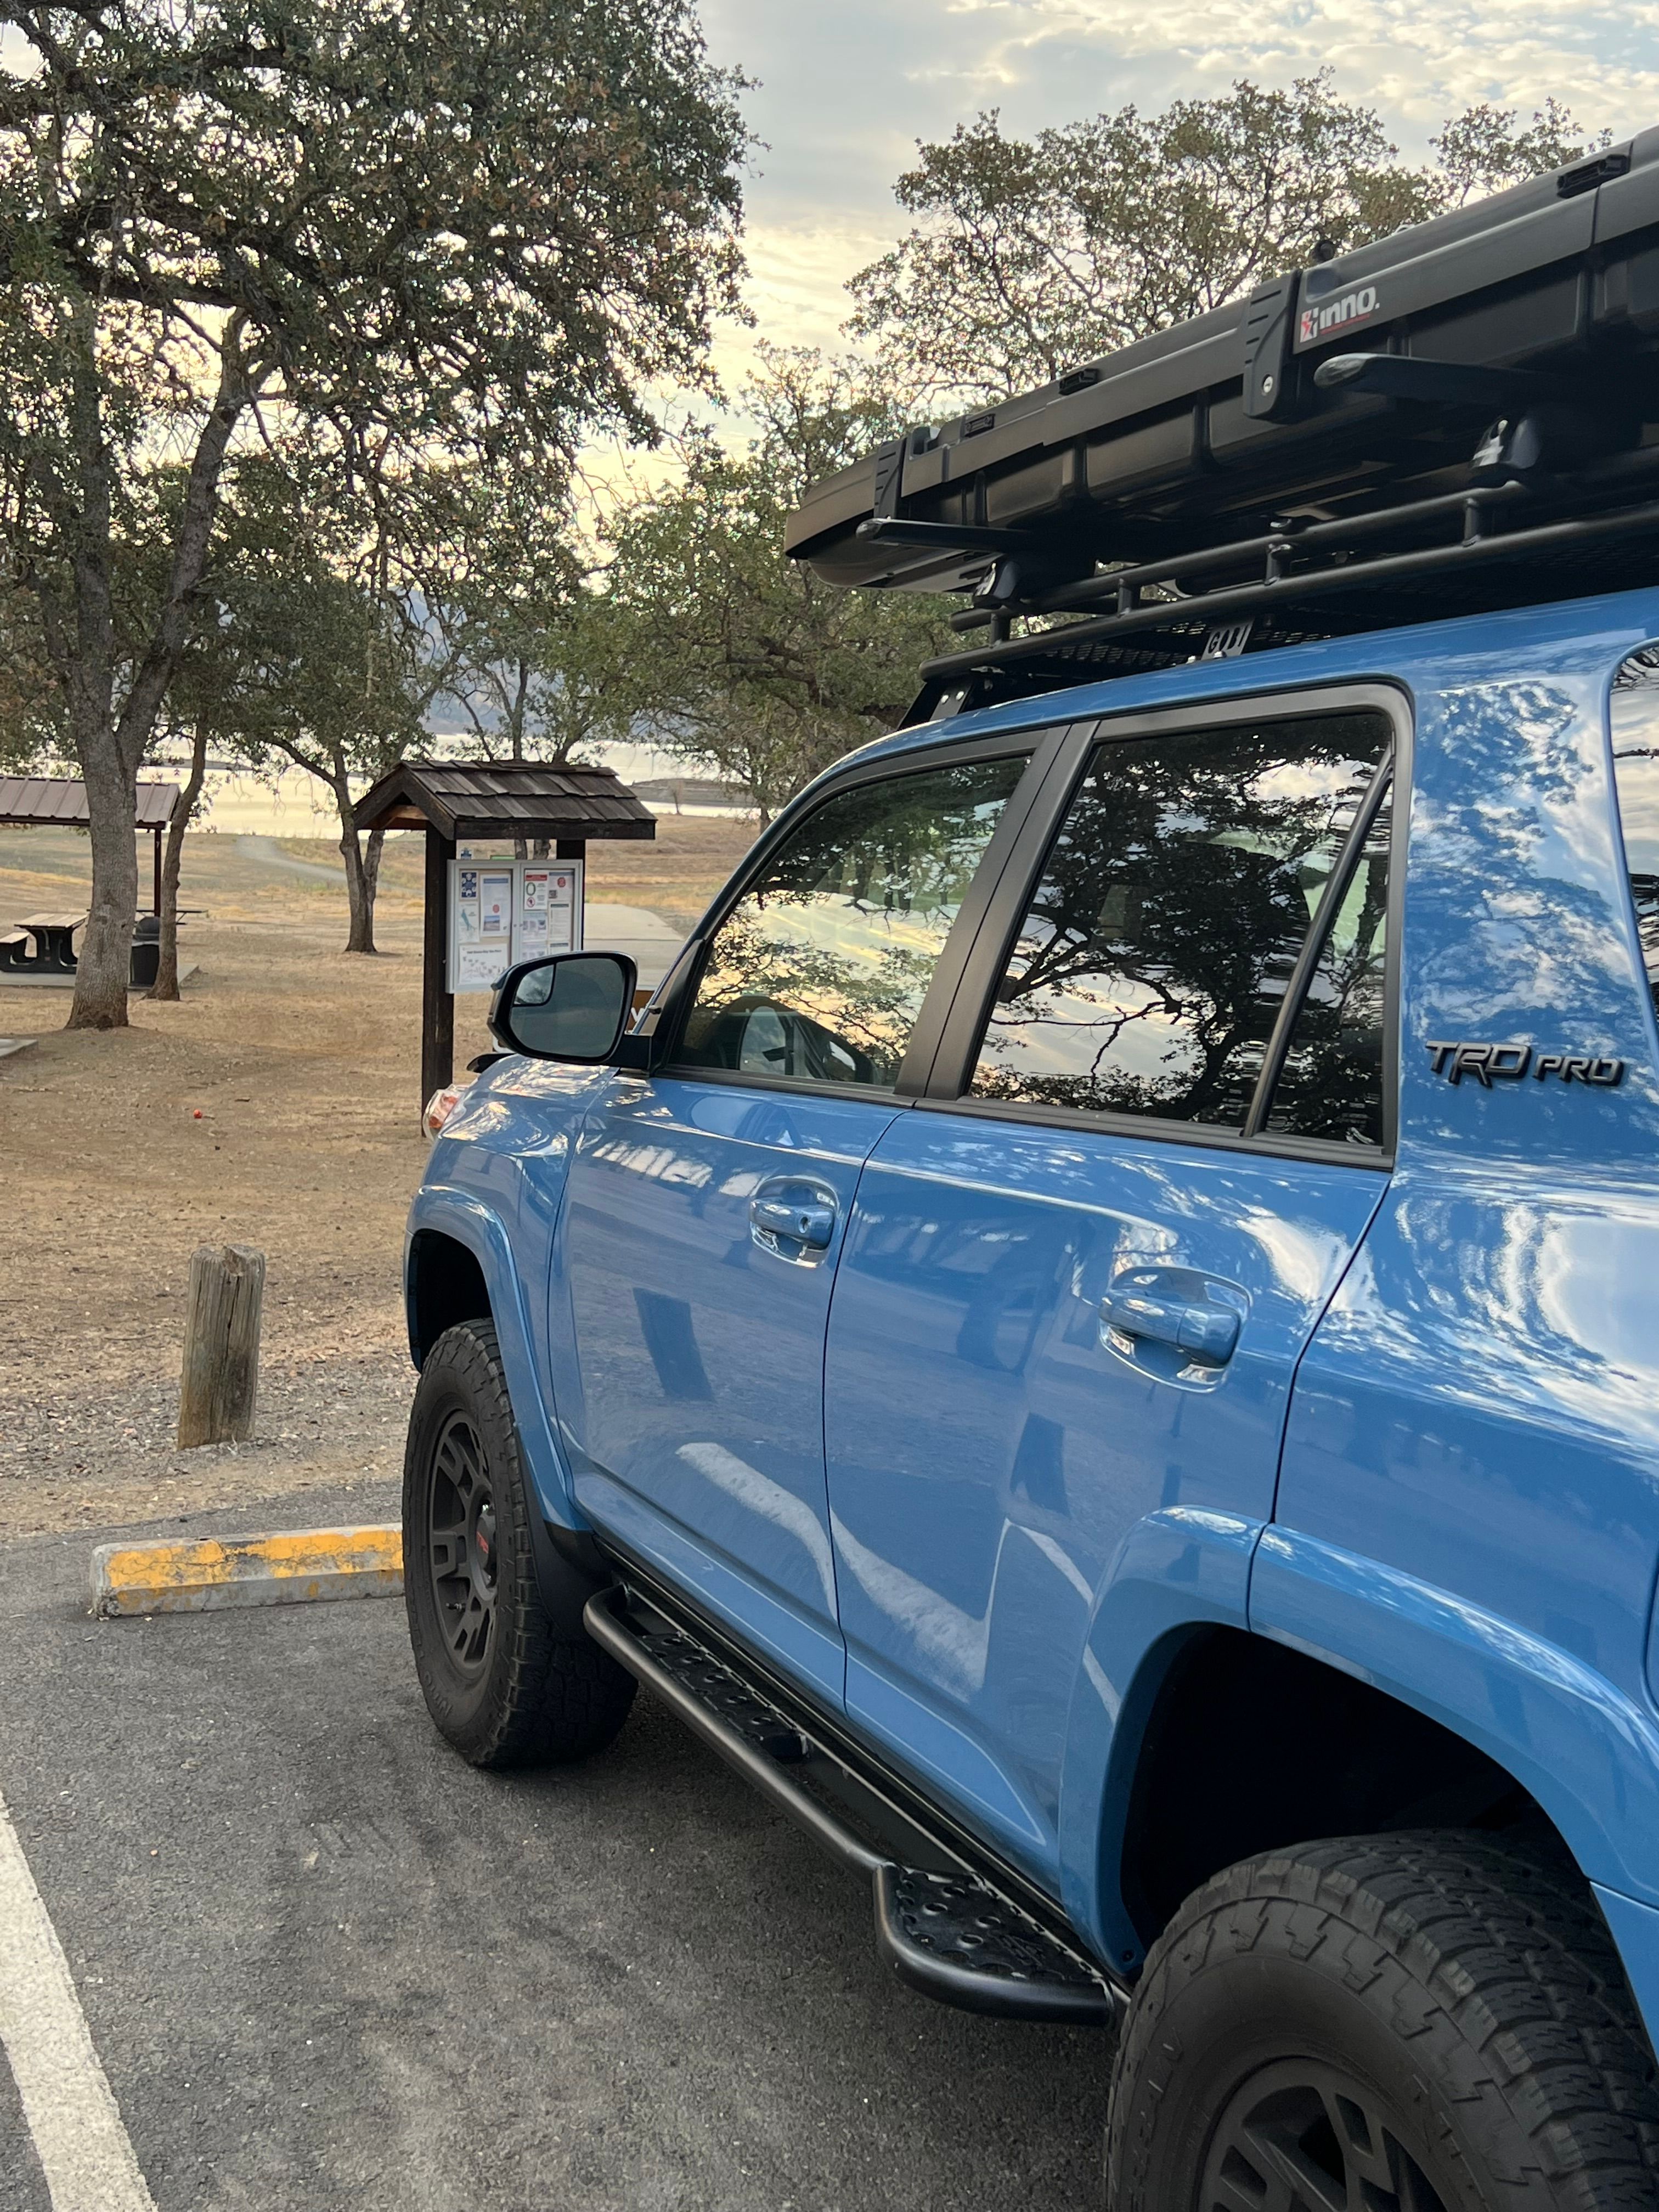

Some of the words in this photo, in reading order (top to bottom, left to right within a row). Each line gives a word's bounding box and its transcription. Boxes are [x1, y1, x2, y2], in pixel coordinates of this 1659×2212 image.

[1207, 624, 1250, 654] GOBI
[1425, 1040, 1531, 1089] TRD
[1533, 1054, 1624, 1087] PRO
